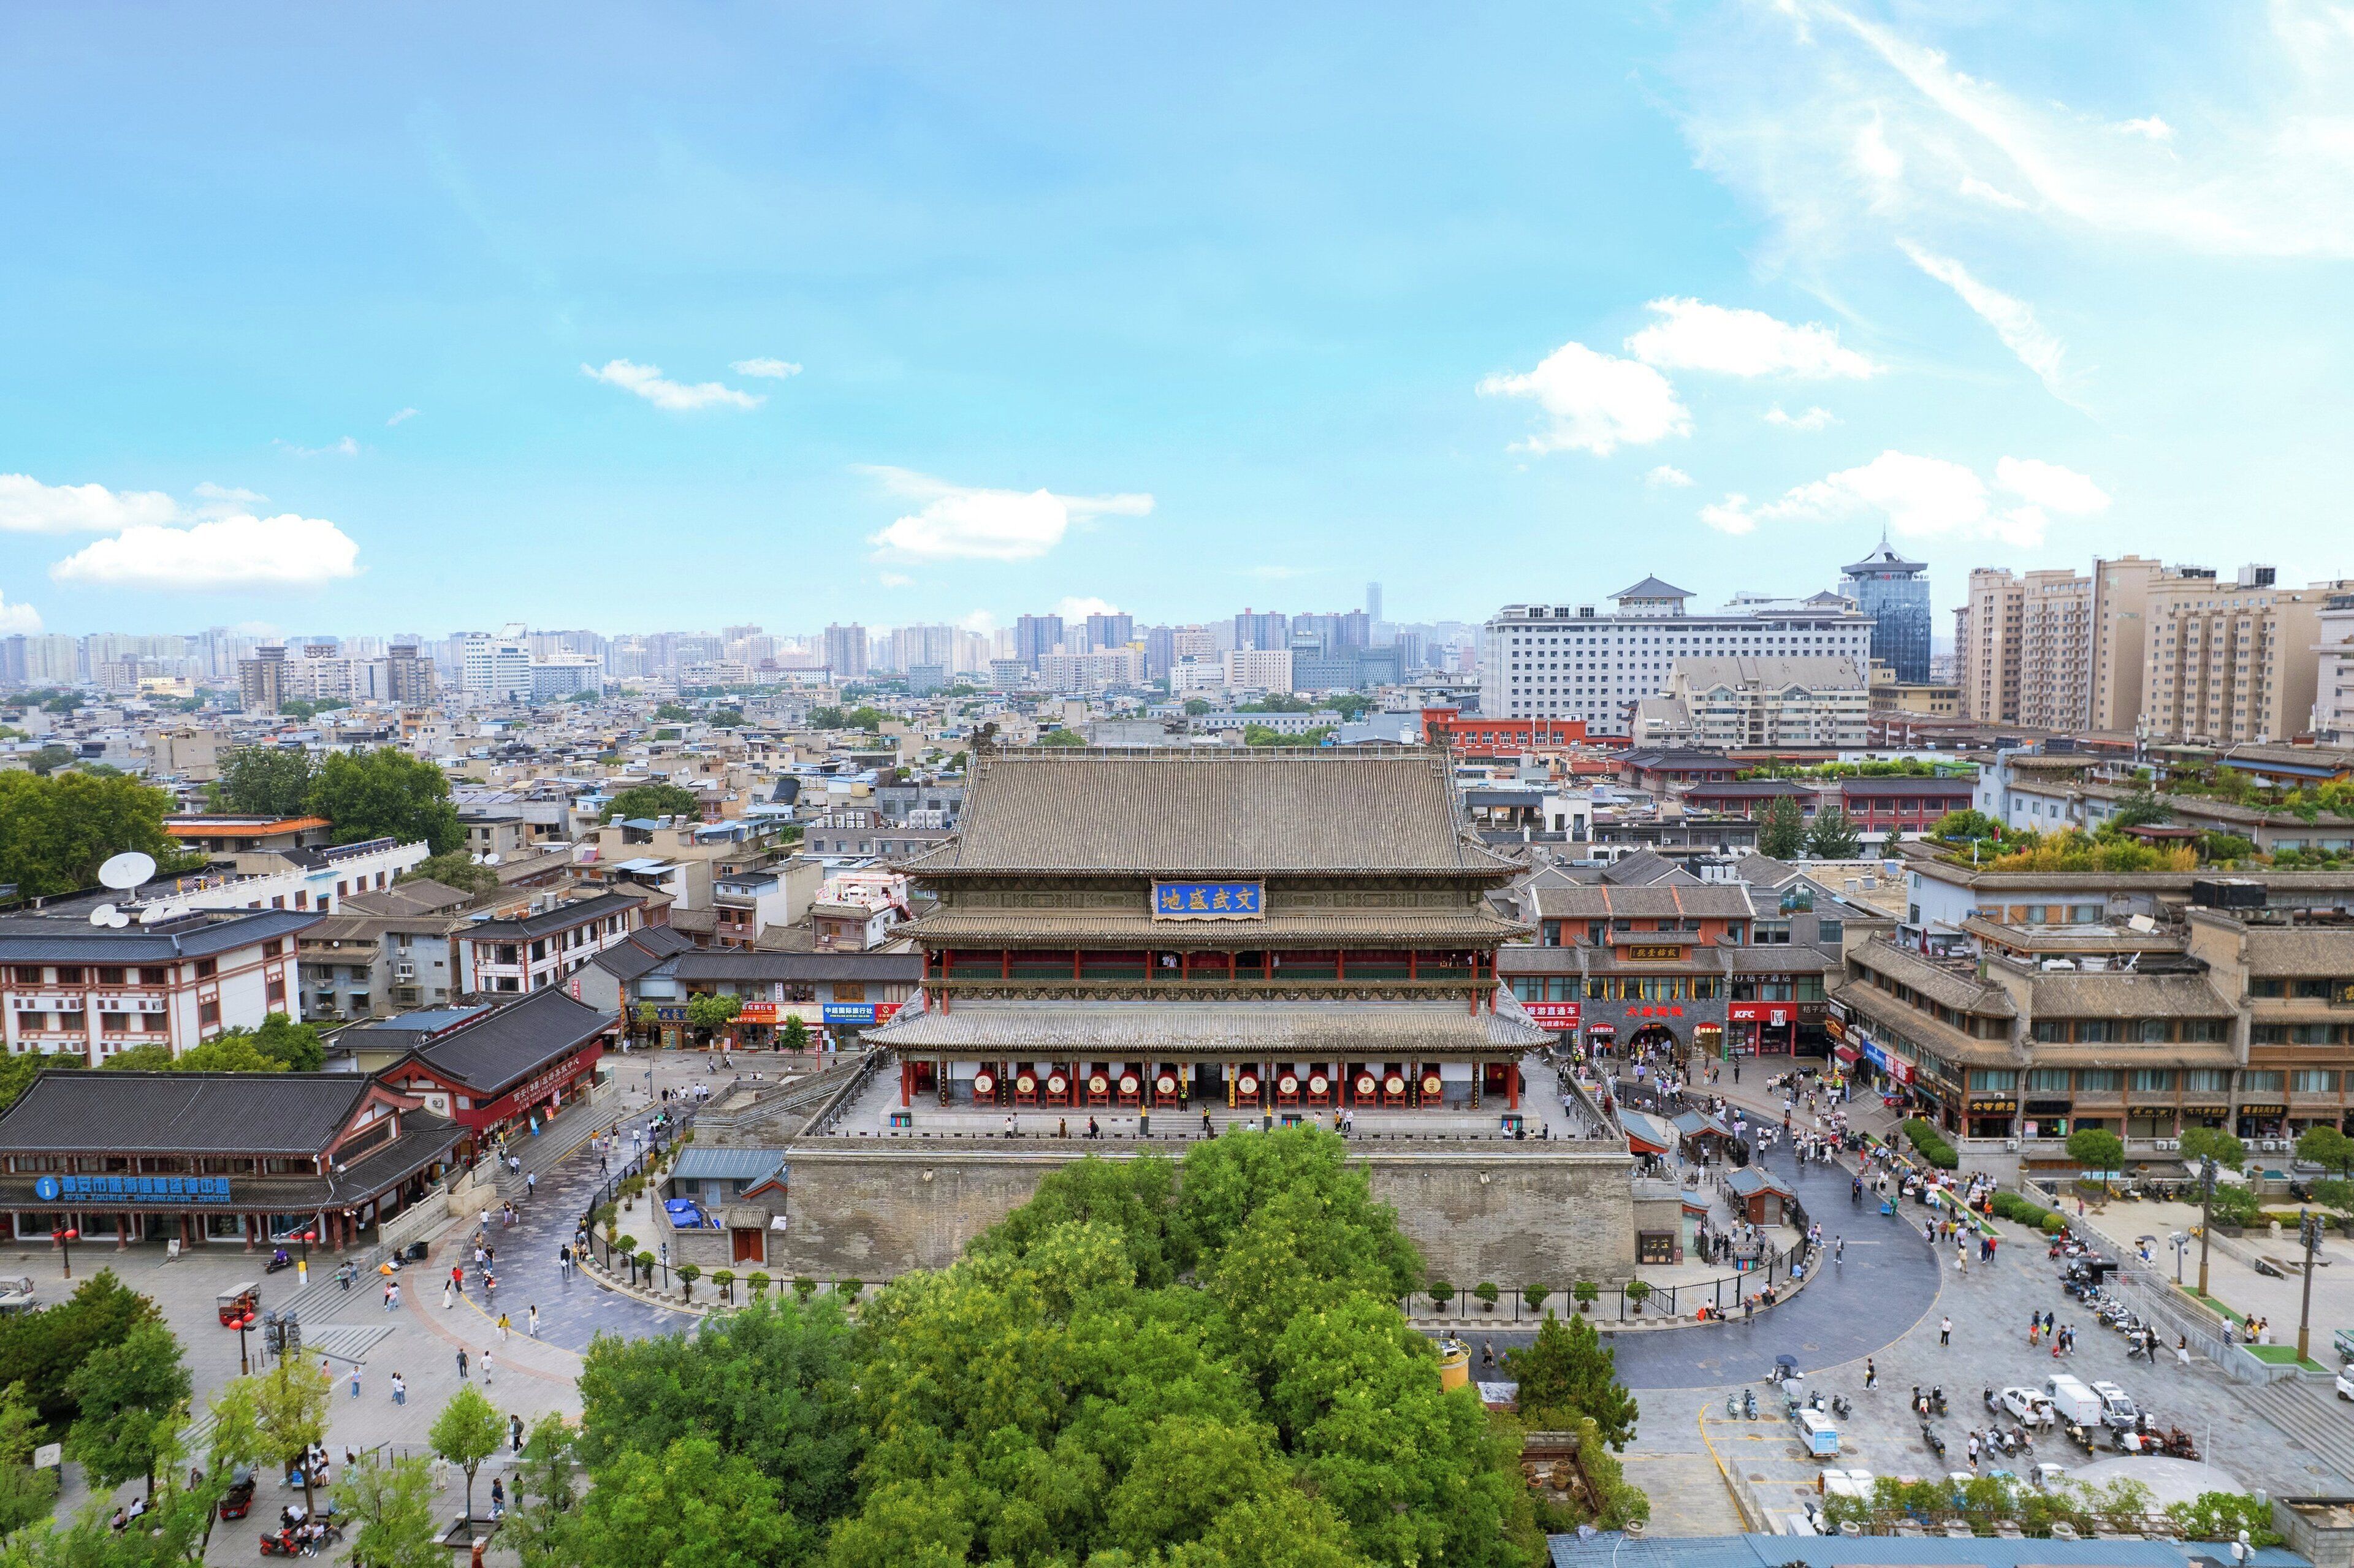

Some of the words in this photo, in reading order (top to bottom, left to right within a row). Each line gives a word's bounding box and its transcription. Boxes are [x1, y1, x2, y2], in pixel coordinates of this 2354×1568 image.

[1523, 1006, 1576, 1016] 旅游直通车
[62, 1176, 230, 1194] 西安市旅游信息咨询中心
